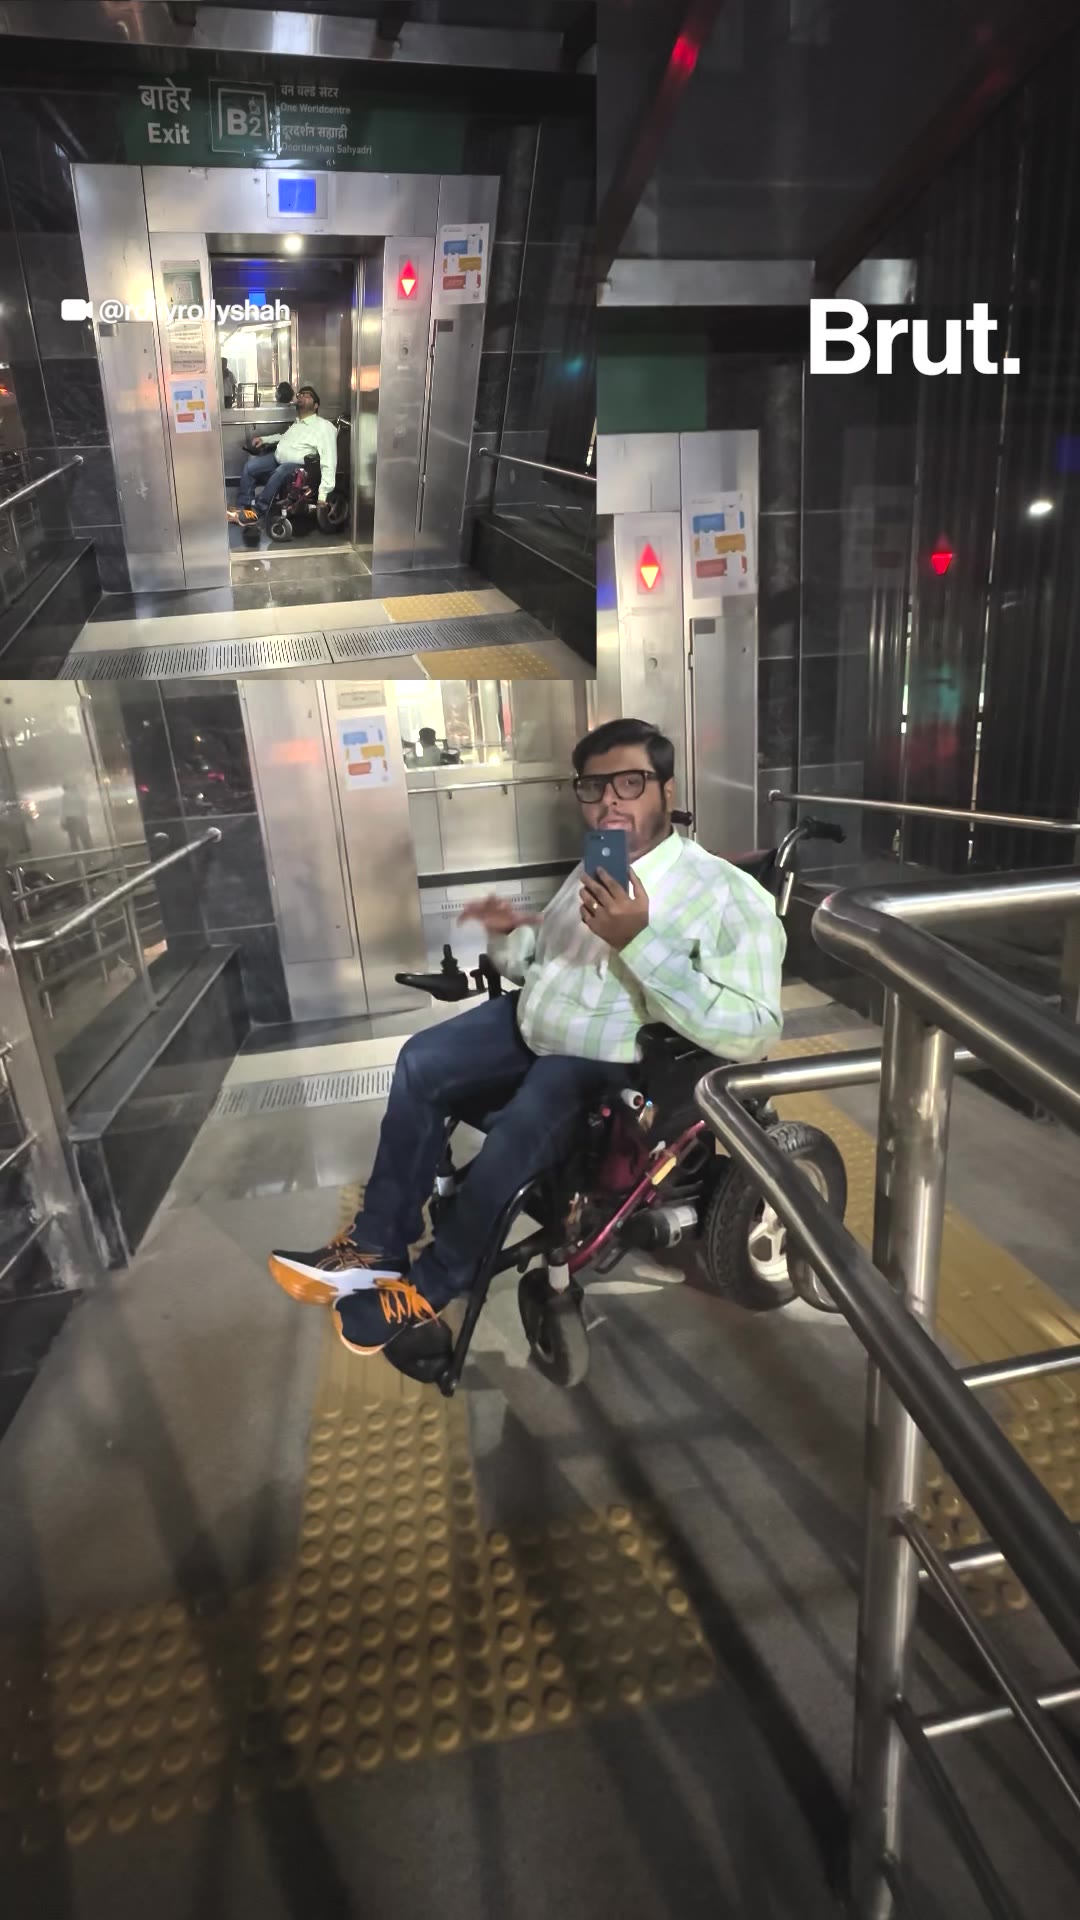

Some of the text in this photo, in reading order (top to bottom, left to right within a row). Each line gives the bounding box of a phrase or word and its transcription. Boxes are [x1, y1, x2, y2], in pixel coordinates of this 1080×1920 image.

[138, 77, 192, 115] बाहेर
[280, 102, 351, 114] One Worldcentre
[147, 122, 191, 144] Exit
[281, 142, 372, 156] Doordarshan Sahyadri
